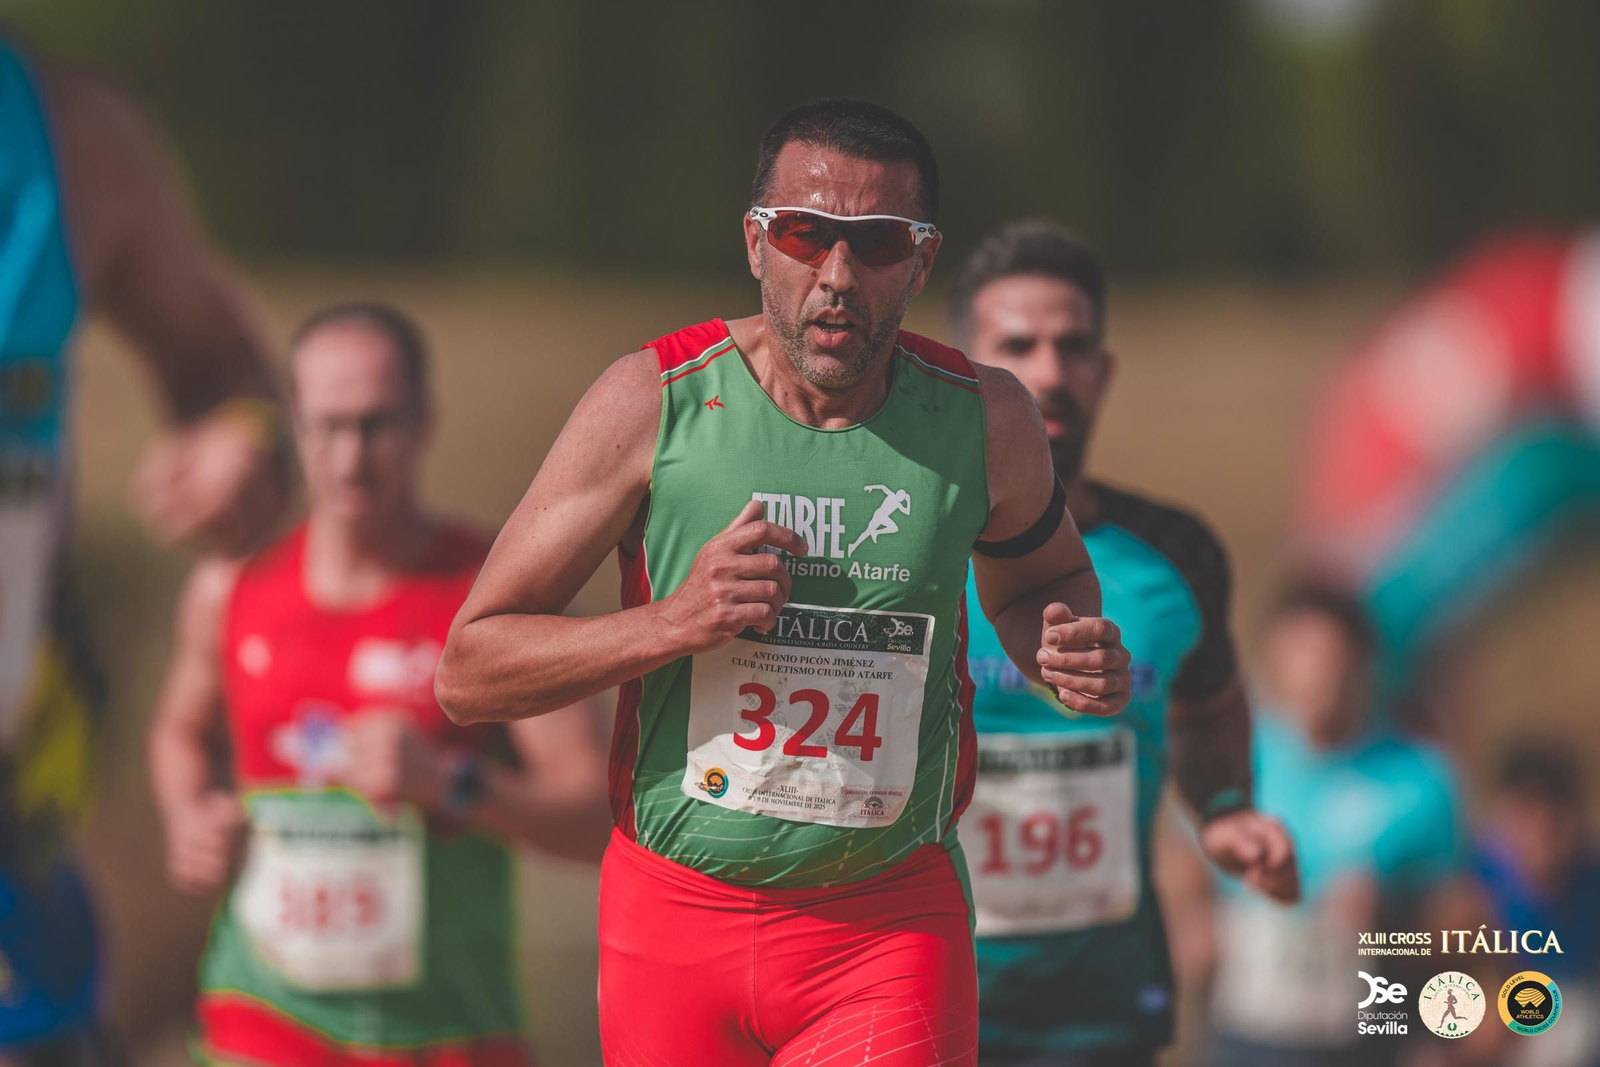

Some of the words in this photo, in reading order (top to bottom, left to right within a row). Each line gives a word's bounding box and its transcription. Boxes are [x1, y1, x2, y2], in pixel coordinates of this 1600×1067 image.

[750, 492, 846, 559] TARFE
[785, 559, 842, 578] tismo
[847, 561, 911, 583] Atarfe
[763, 612, 870, 643] TÁLICA
[761, 637, 814, 647] INTERNATIONAL
[731, 657, 757, 668] CLUB
[757, 662, 815, 676] ATLETISMO
[817, 668, 855, 679] CIUDAD
[857, 671, 893, 680] ATARFE
[752, 651, 798, 664] ANTONIO
[800, 654, 831, 667] PICÓN
[832, 656, 875, 668] JIMÉNEZ
[733, 682, 882, 762] 324
[758, 790, 804, 802] INTERNACIONAL
[771, 798, 803, 808] NOVIEMBRE
[975, 804, 1104, 877] 196
